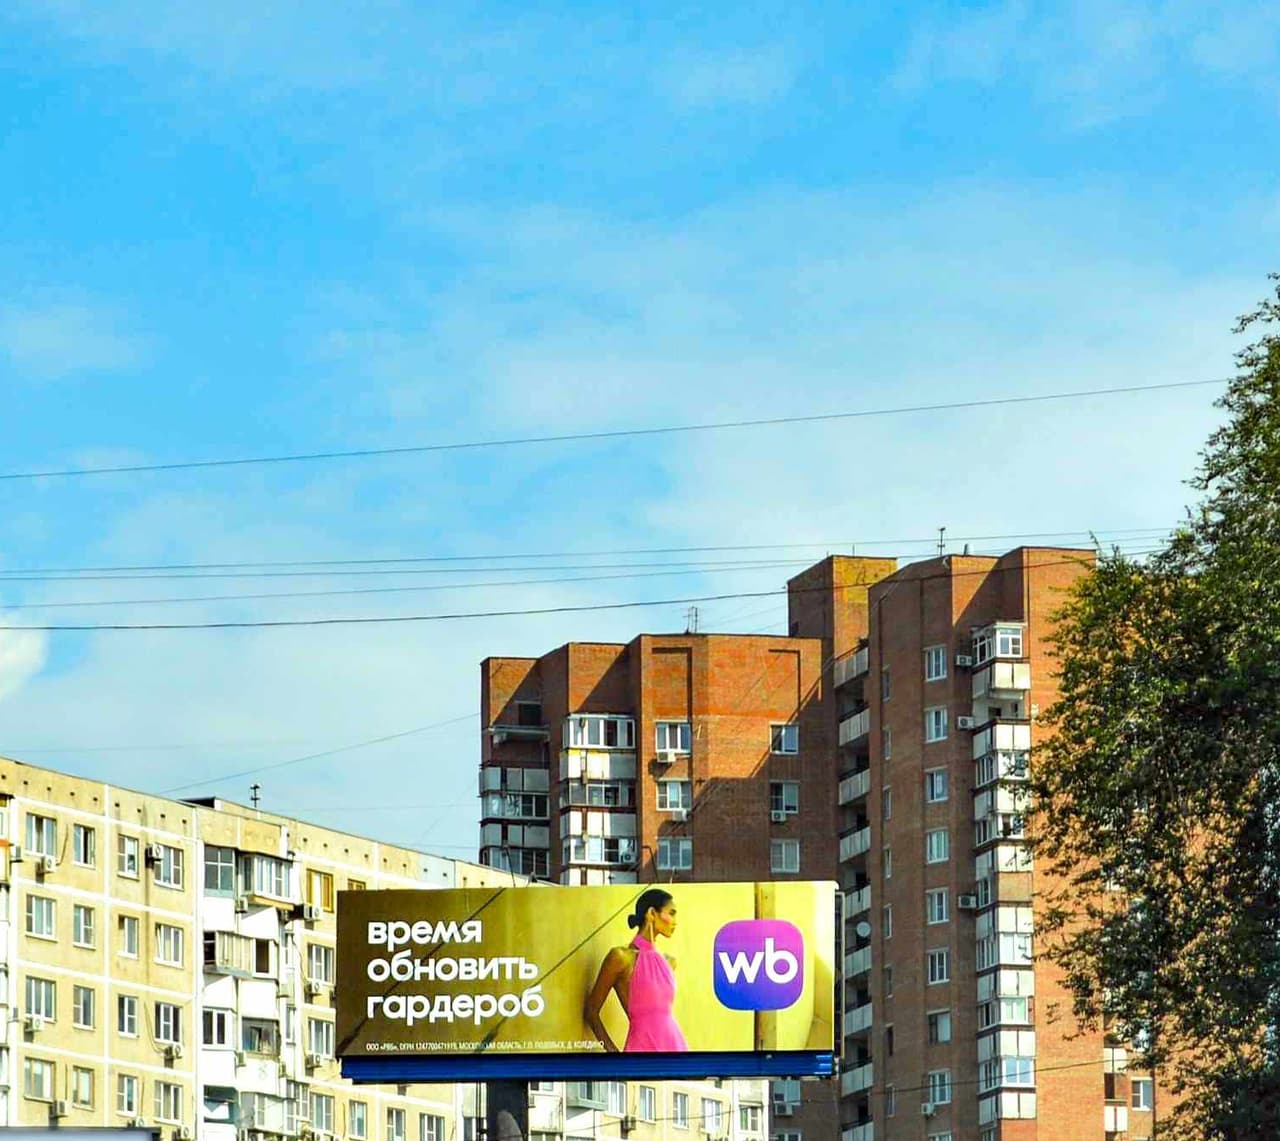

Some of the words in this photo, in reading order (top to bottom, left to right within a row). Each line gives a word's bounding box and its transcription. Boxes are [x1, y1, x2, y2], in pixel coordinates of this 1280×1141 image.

[367, 920, 482, 952] время
[367, 949, 539, 982] обновить
[718, 937, 799, 984] wb
[367, 985, 545, 1026] гардероб
